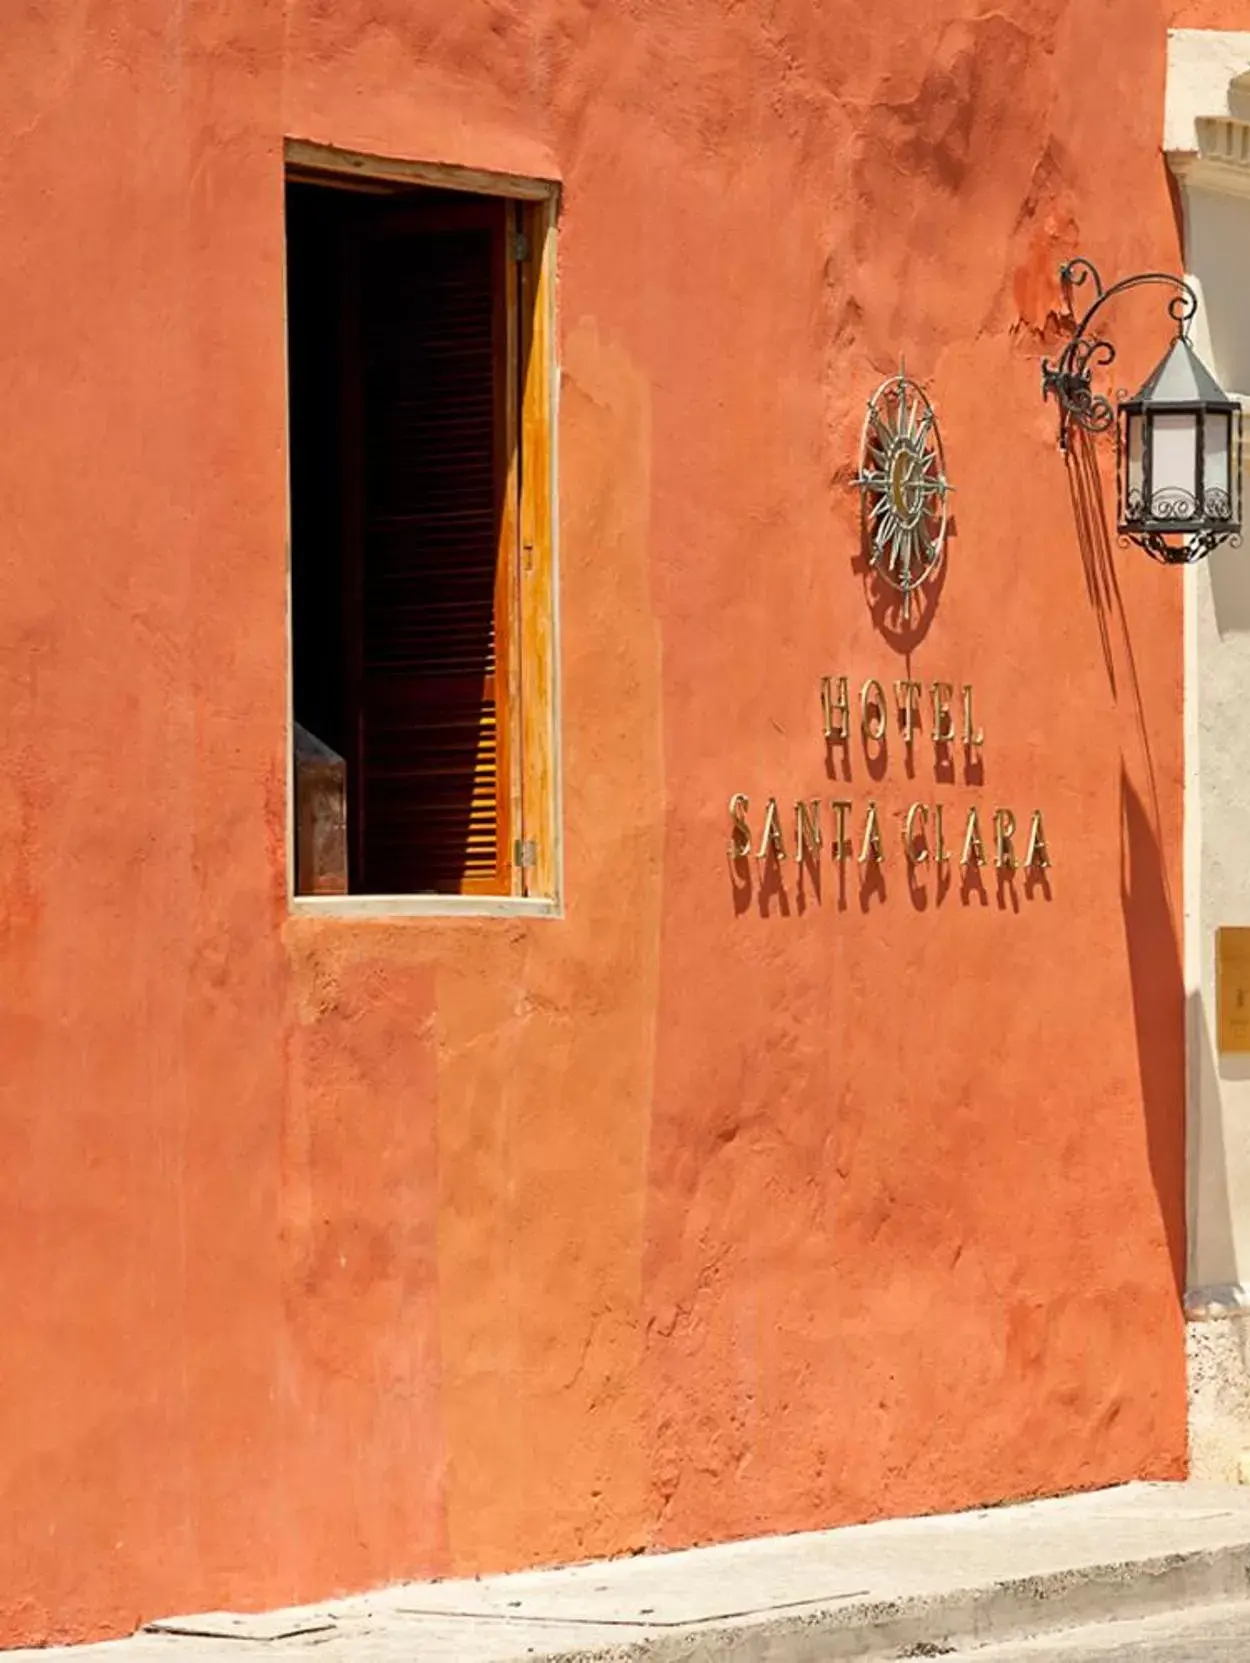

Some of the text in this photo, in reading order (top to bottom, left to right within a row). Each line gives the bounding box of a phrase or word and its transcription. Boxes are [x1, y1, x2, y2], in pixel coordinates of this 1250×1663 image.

[820, 676, 985, 746] HOTEL
[727, 792, 1052, 868] SANTA CLARA
